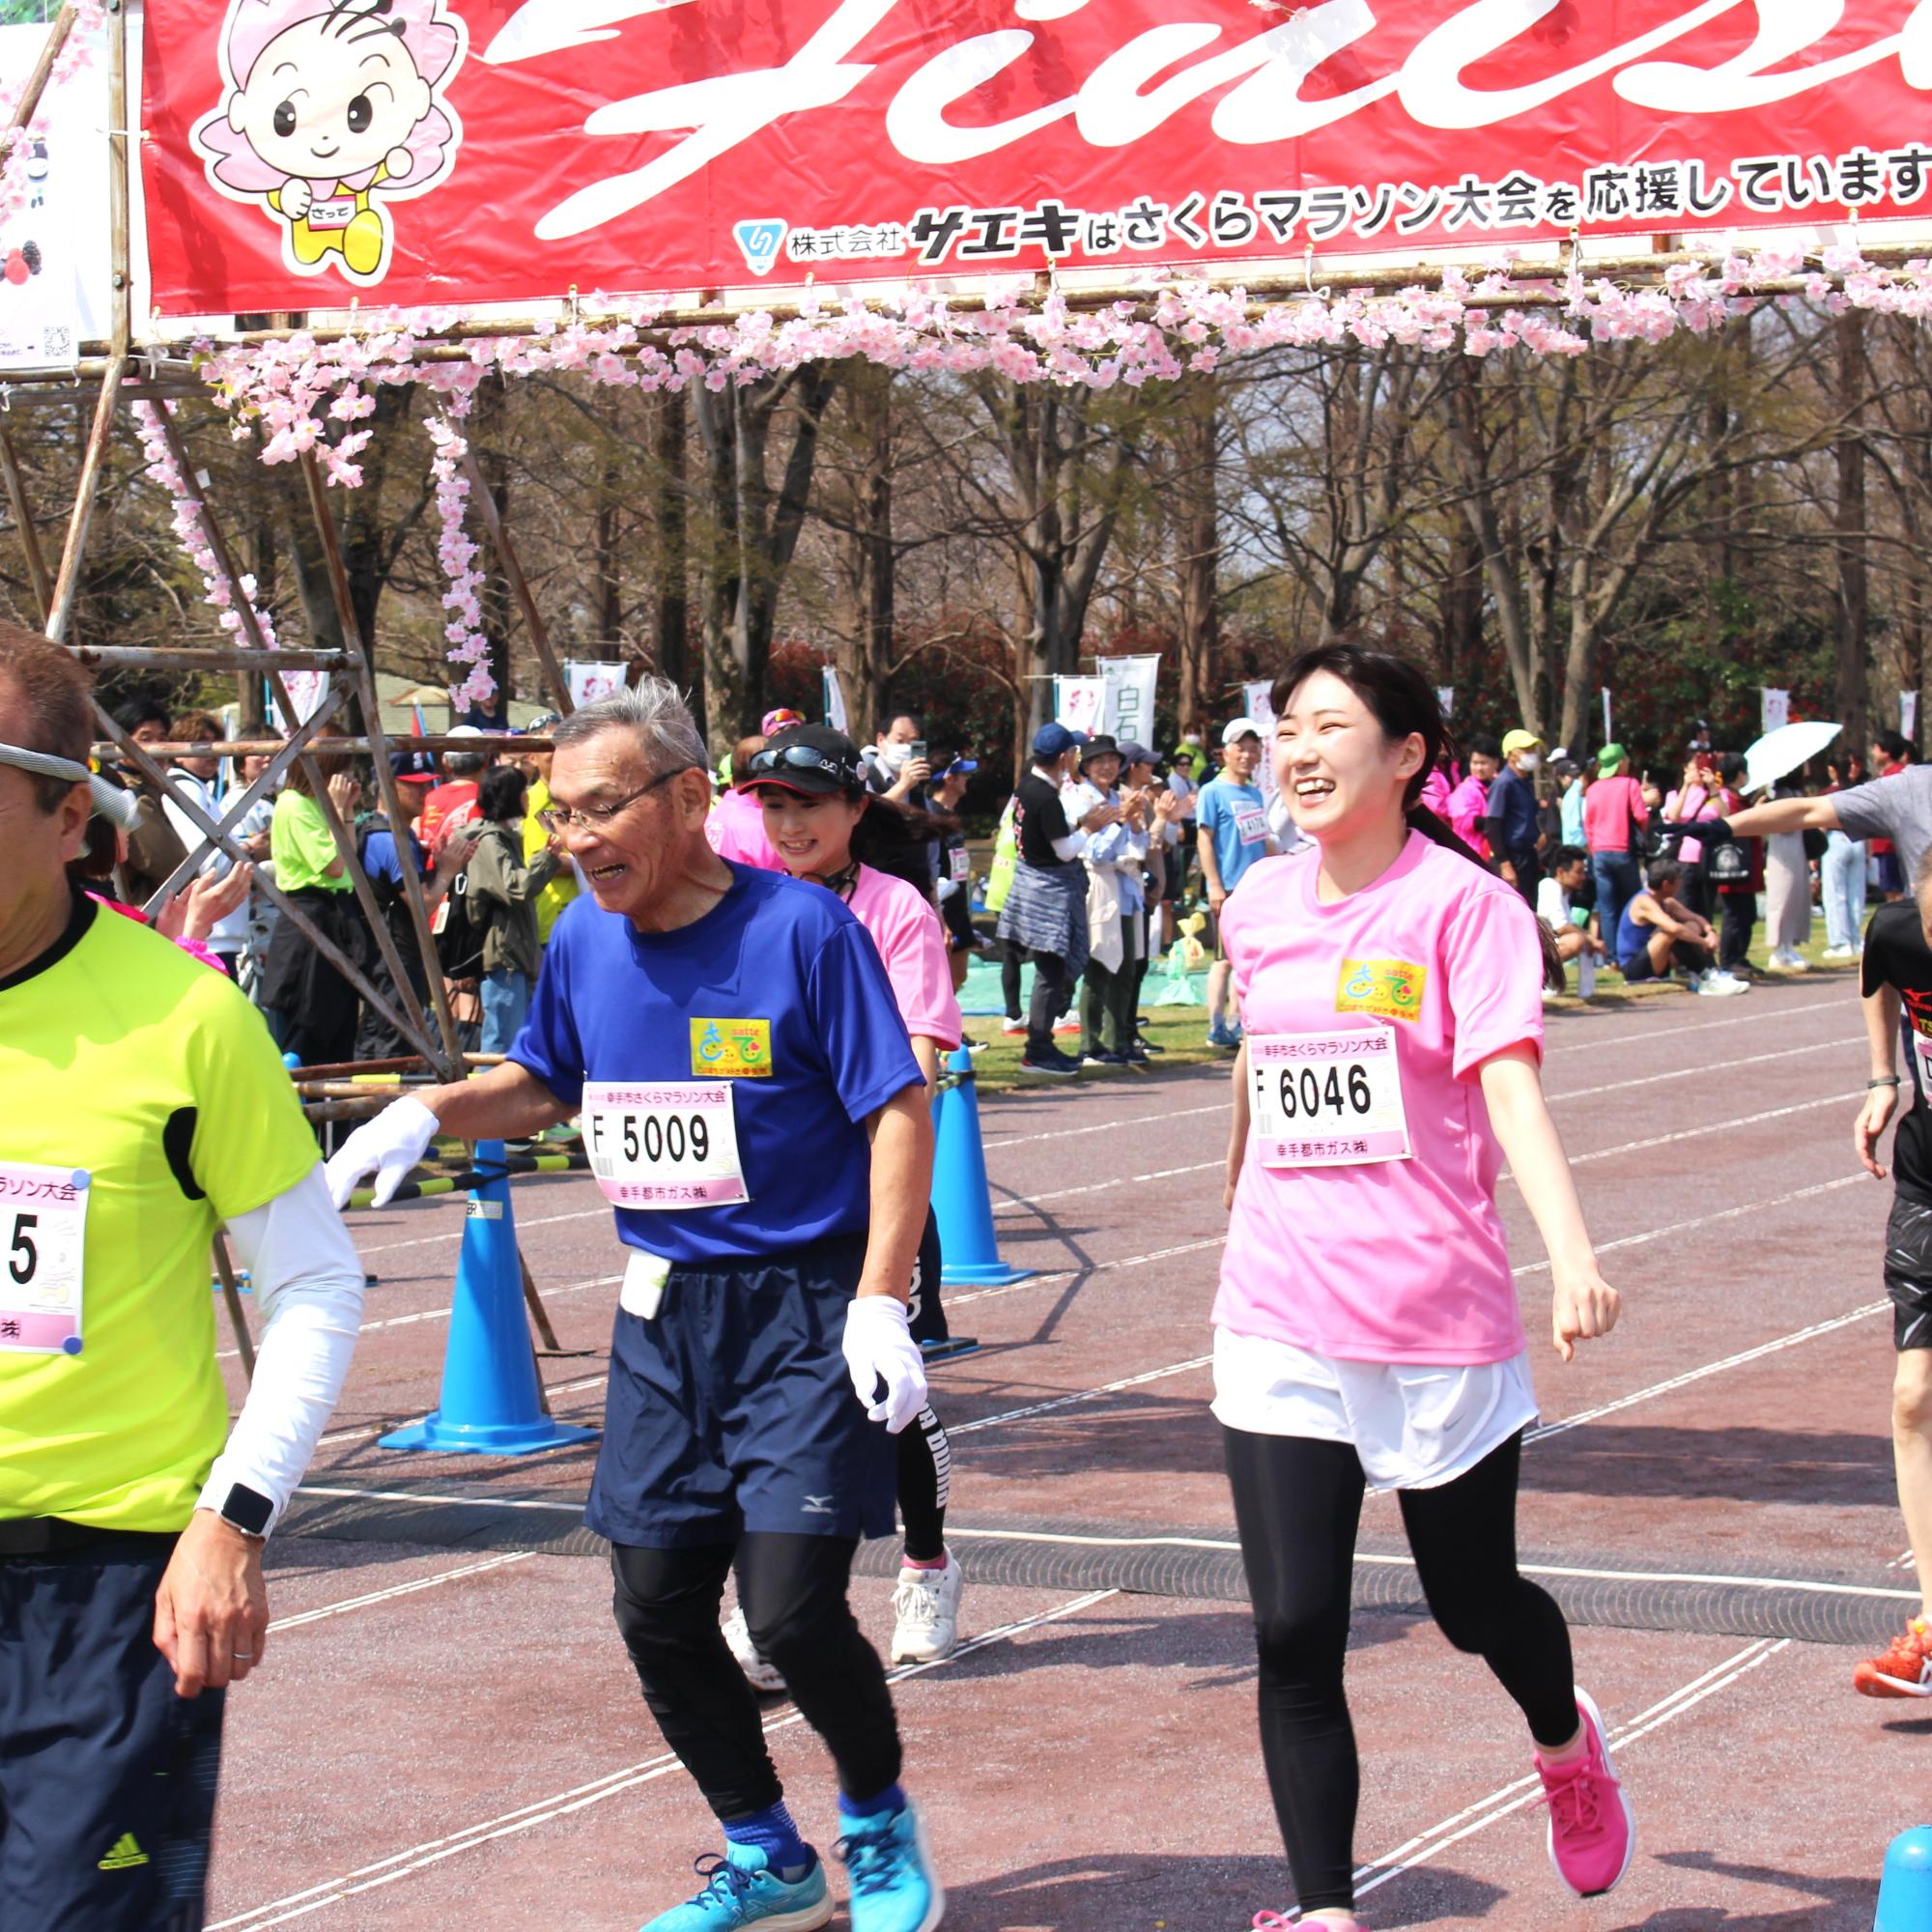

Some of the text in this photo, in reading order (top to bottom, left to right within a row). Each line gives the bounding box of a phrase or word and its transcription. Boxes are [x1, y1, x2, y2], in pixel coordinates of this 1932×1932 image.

[484, 0, 1932, 241] Finis
[311, 207, 349, 219] さって
[1280, 1065, 1371, 1118] 6046
[593, 1115, 708, 1162] F 5009
[9, 1213, 38, 1285] 5
